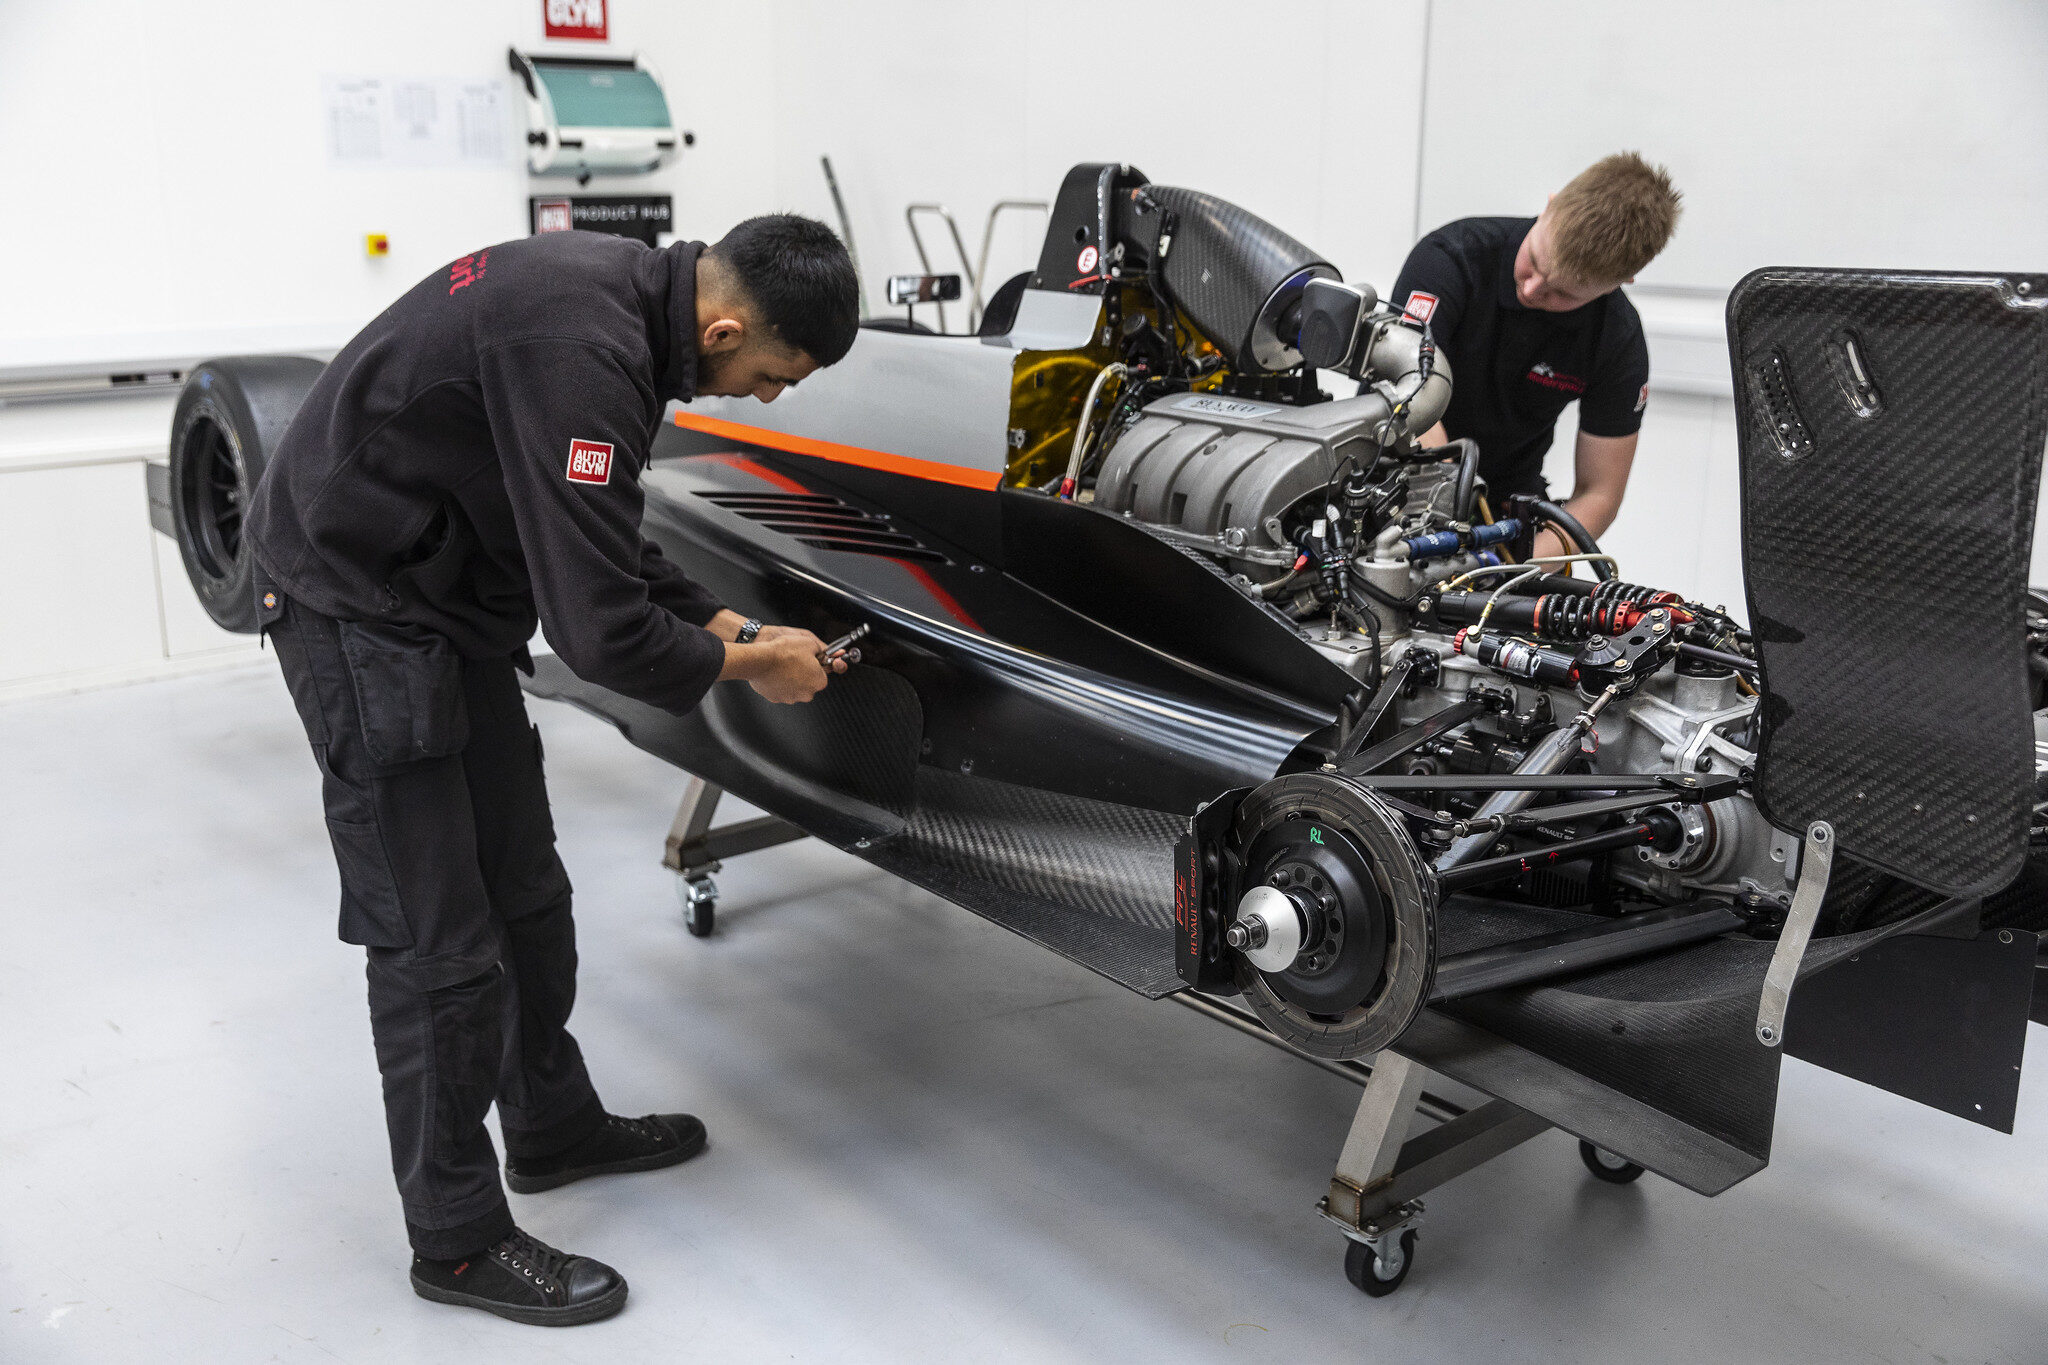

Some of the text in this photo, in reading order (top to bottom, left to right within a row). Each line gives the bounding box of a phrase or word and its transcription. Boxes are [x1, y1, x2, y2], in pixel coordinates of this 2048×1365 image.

[449, 256, 475, 296] ort
[574, 448, 608, 464] AUTO
[572, 459, 606, 476] GLYM
[1310, 826, 1325, 845] RL
[1190, 901, 1199, 956] RENAULT
